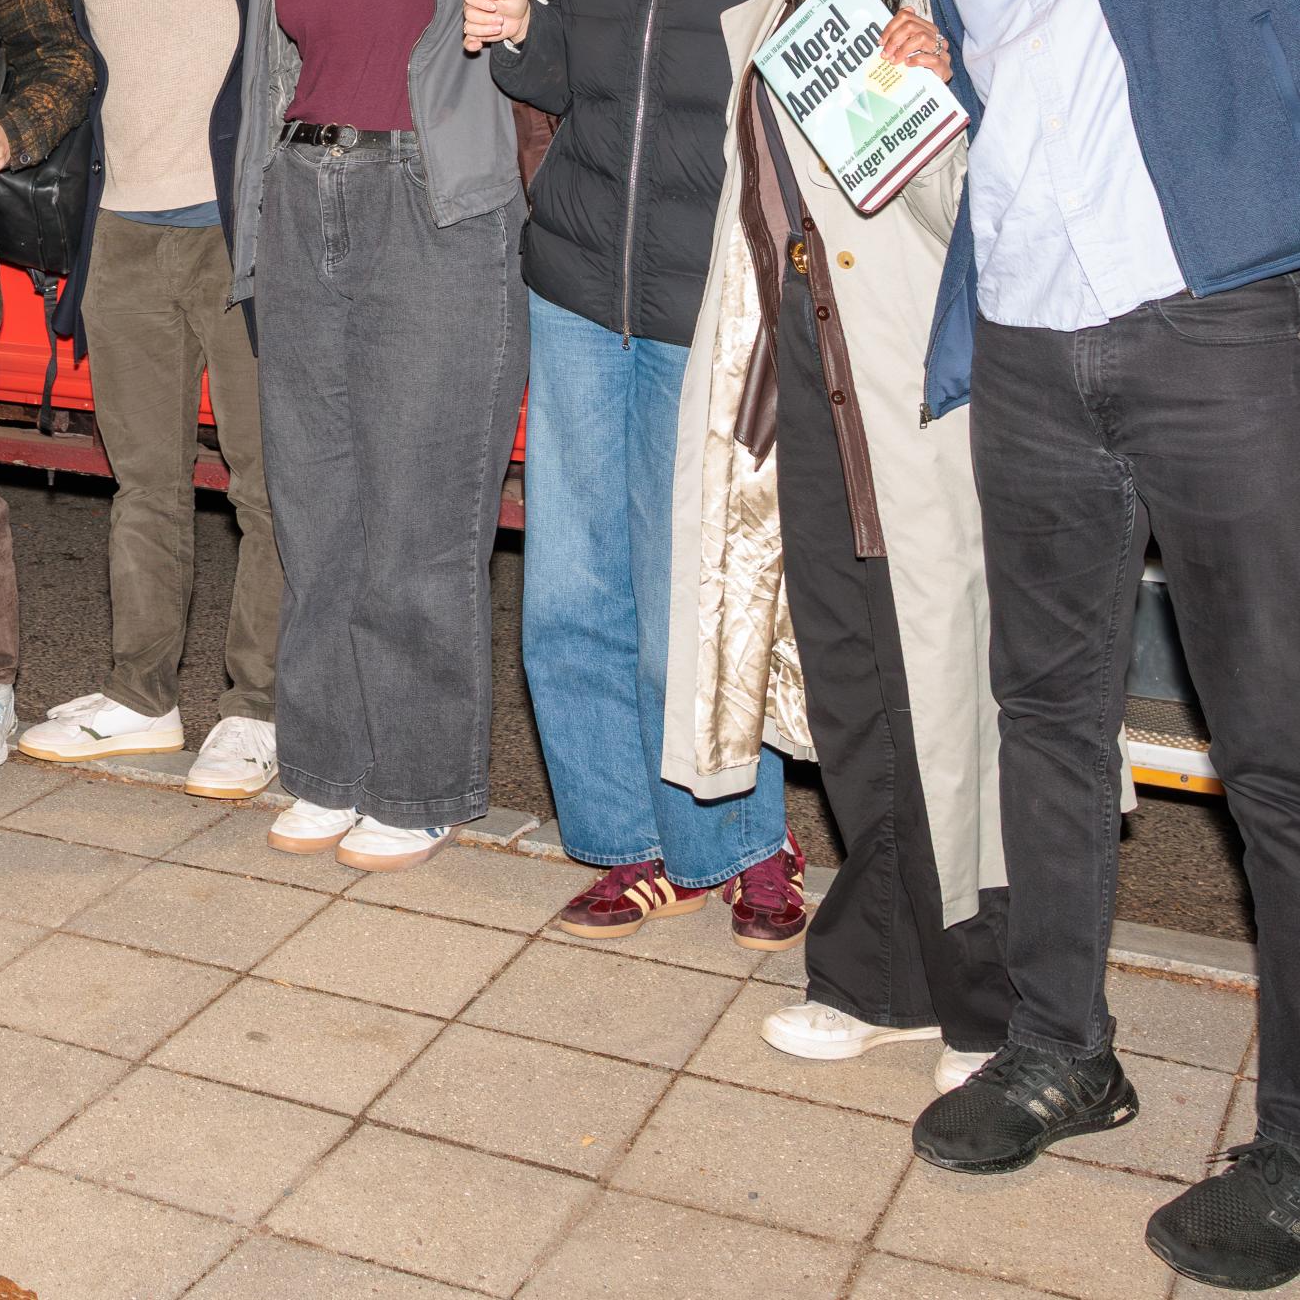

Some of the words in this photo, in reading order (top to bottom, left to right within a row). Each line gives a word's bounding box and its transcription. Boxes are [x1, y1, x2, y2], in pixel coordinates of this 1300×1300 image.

[781, 3, 851, 79] Moral
[786, 21, 884, 123] Ambition
[842, 147, 885, 192] Rutger
[880, 97, 940, 153] Bregman
